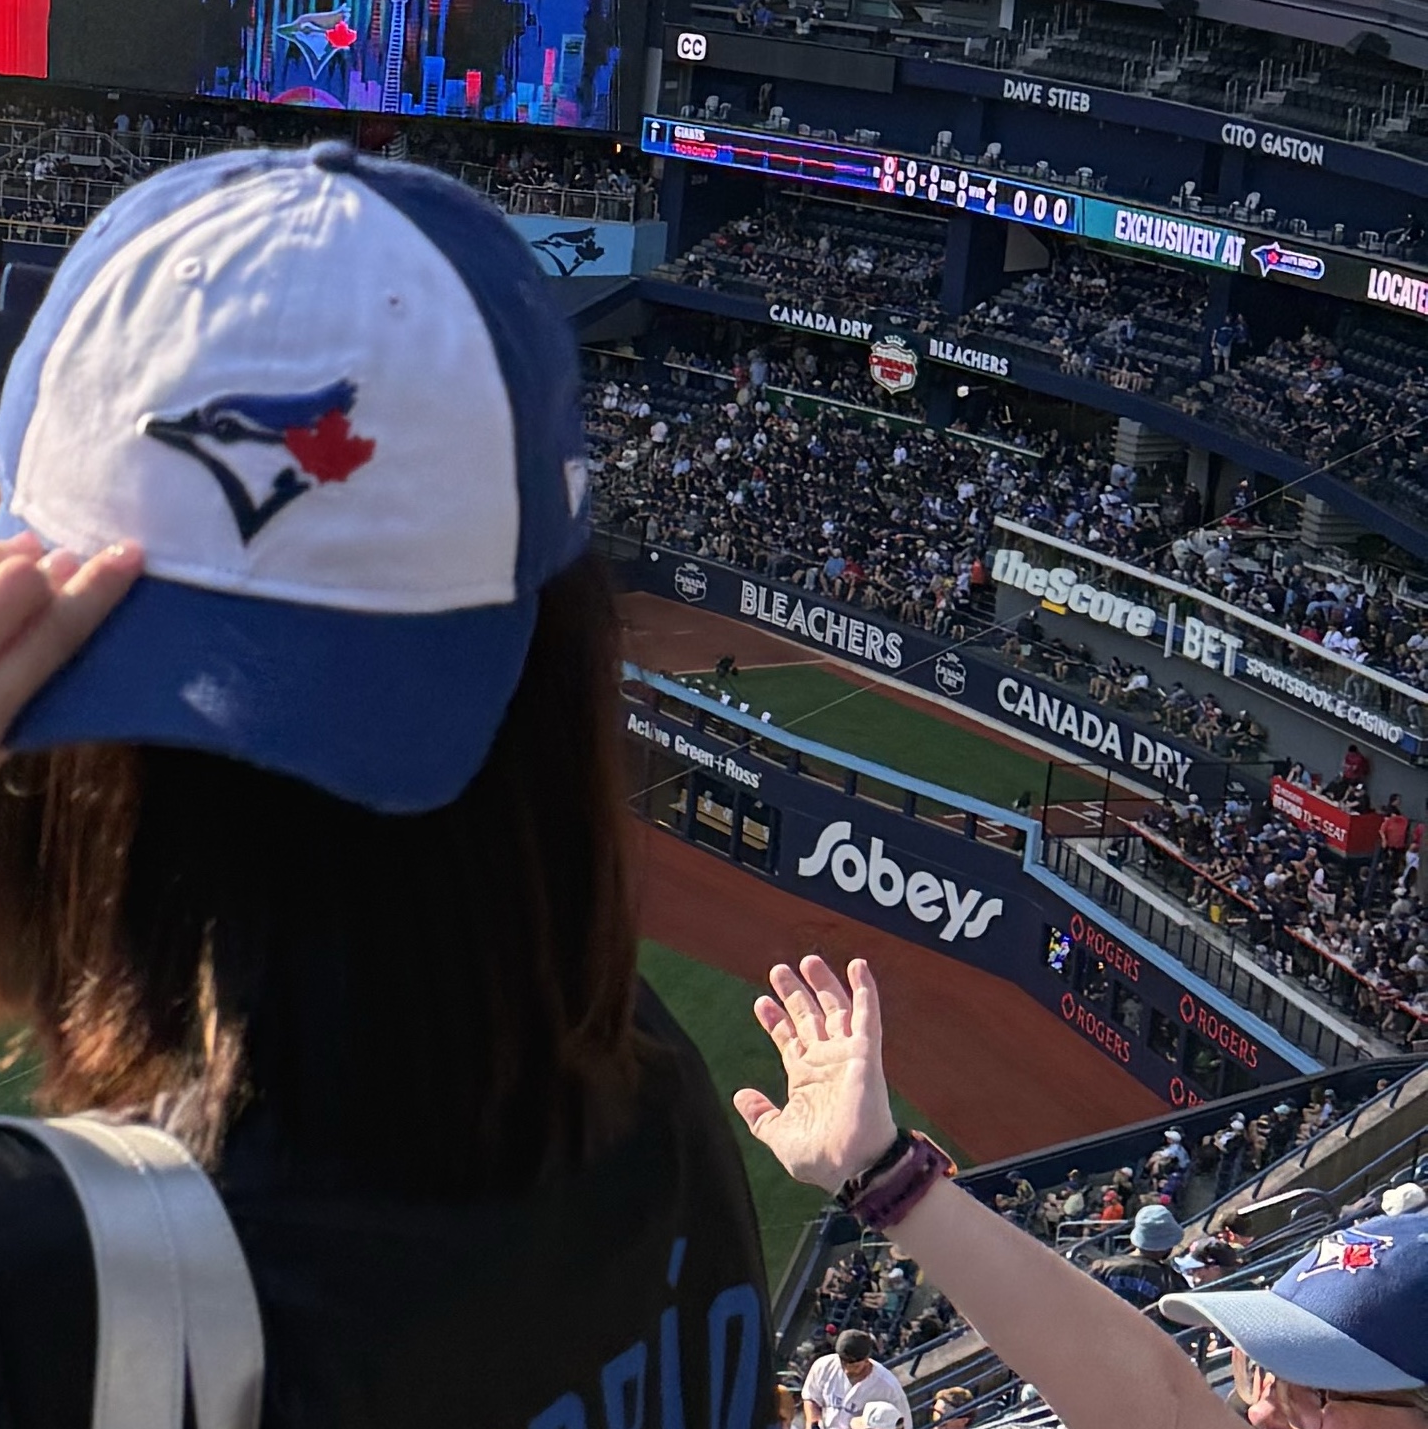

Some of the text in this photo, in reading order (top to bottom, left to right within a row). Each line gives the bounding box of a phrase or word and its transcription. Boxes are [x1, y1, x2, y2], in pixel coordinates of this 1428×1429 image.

[680, 37, 703, 57] CC
[1003, 78, 1090, 113] DAVE STIEB
[1221, 122, 1324, 166] CITO GASTON
[1114, 209, 1221, 261] EXCLUSIVELY
[1221, 234, 1244, 267] AT
[769, 304, 837, 333] CANADA
[840, 319, 873, 340] DRY
[929, 338, 1009, 377] BLEACHERS
[740, 580, 903, 669] BLEACHERS
[991, 549, 1157, 637] theScore
[1182, 616, 1243, 678] BET
[1246, 656, 1337, 715] SPORTSBOOK
[1347, 705, 1406, 744] CASINO
[627, 713, 671, 749] Active
[996, 677, 1124, 762] CANADA
[1322, 820, 1347, 842] SEAT
[798, 821, 1003, 942] Sobeys
[1086, 925, 1141, 982] ROGERS
[1076, 1004, 1130, 1063] ROGERS
[1197, 1007, 1258, 1068] ROGERS
